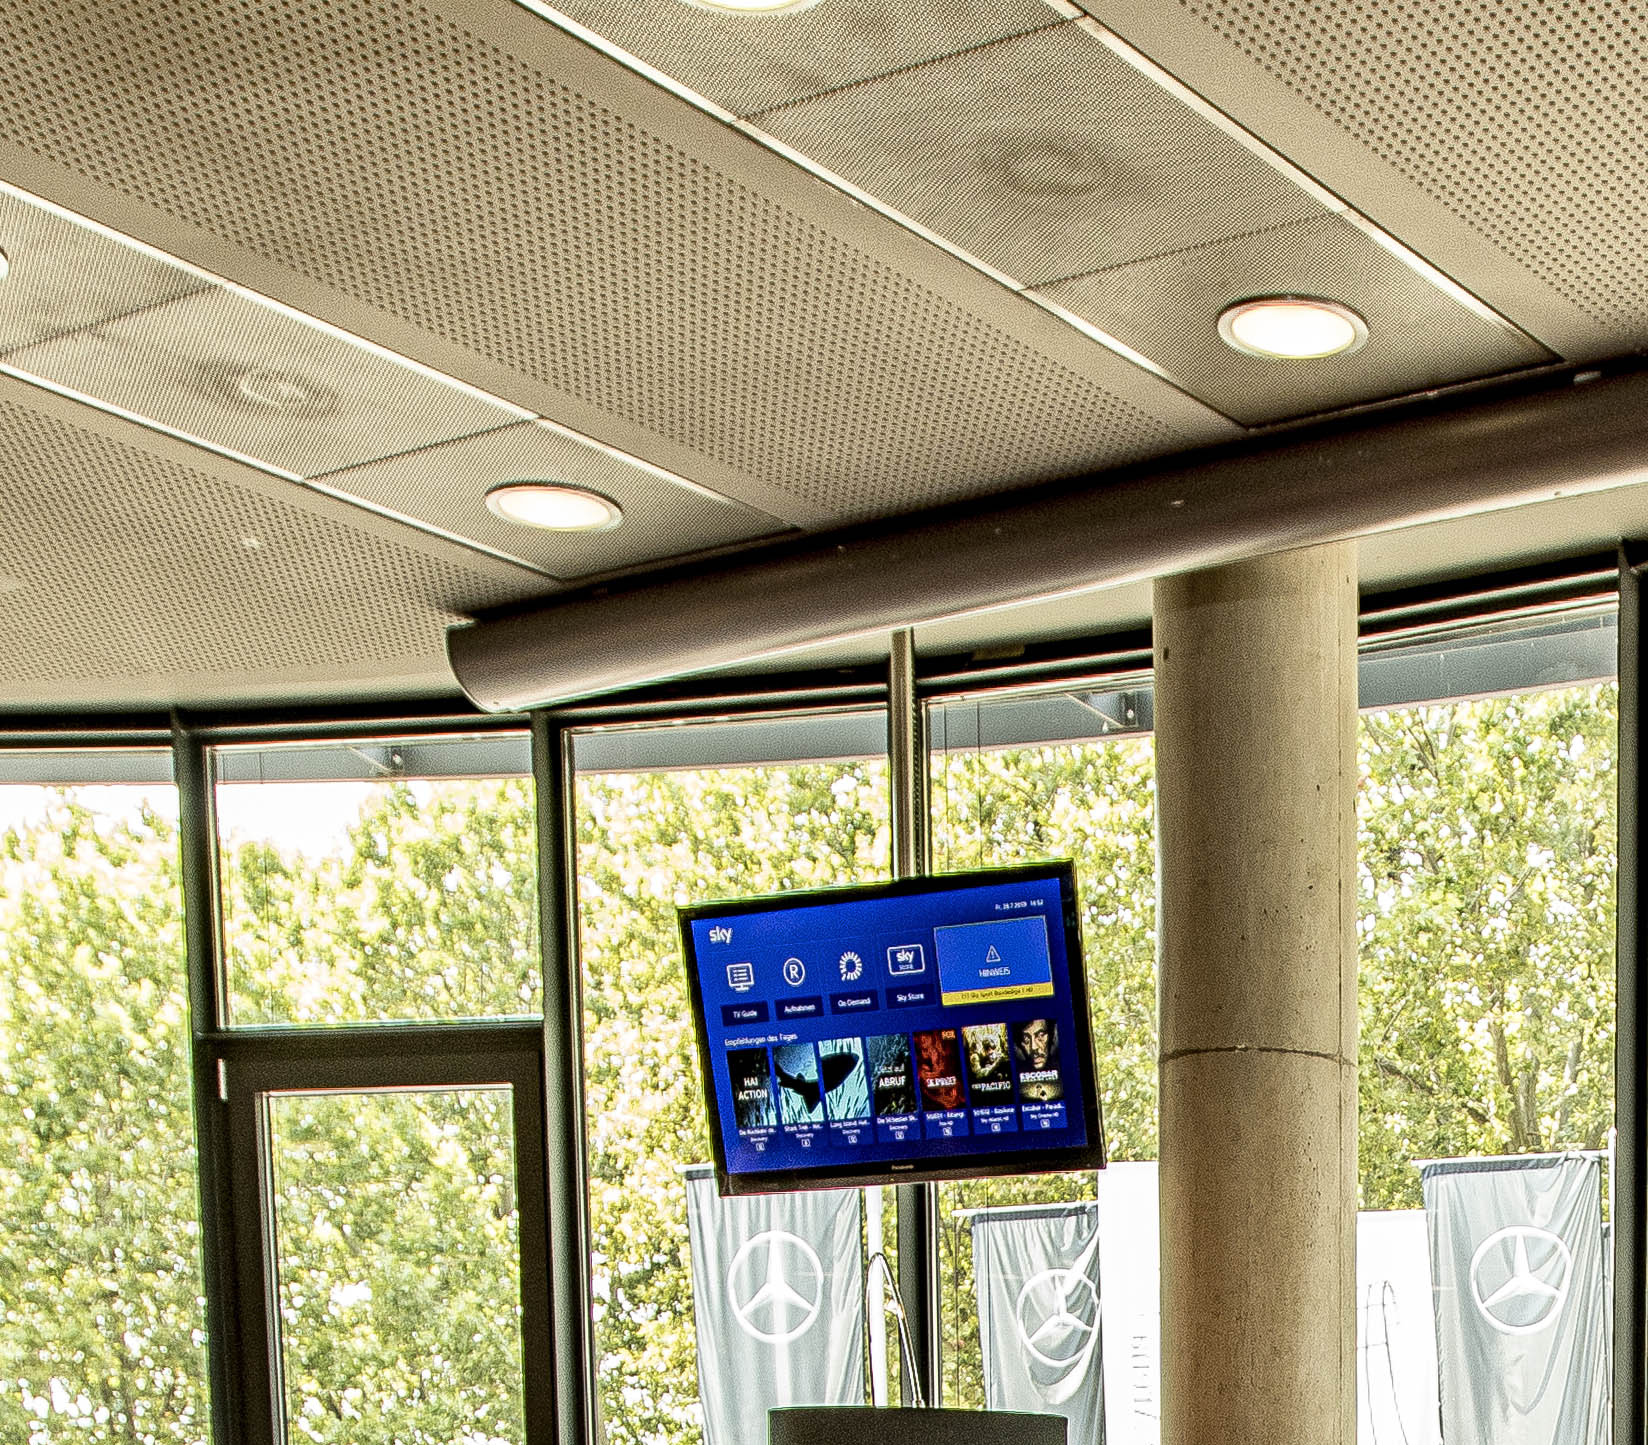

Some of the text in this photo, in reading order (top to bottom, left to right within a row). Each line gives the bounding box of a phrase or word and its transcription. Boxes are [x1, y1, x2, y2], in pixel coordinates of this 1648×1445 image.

[709, 926, 733, 944] sky
[896, 949, 914, 963] sky
[744, 1077, 758, 1087] HAI
[879, 1076, 906, 1088] ABRUF
[738, 1089, 767, 1101] ACTION
